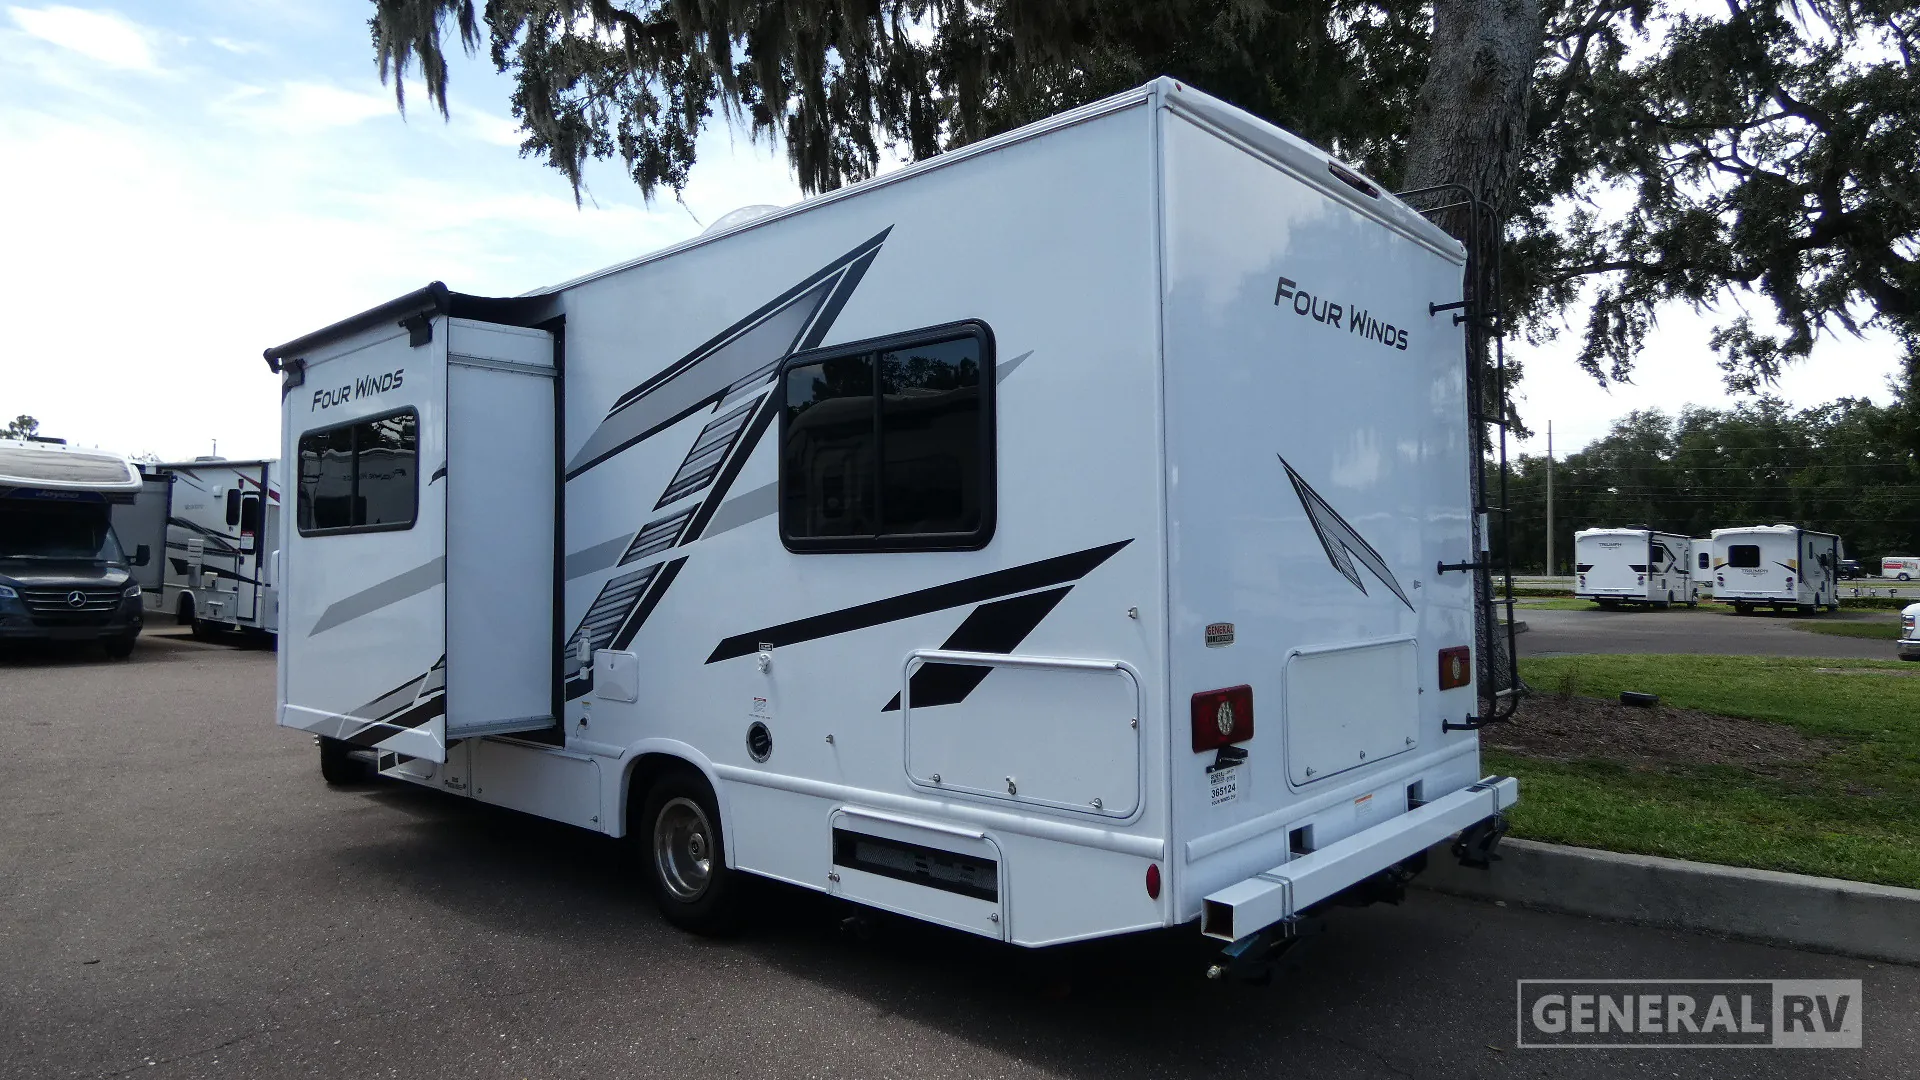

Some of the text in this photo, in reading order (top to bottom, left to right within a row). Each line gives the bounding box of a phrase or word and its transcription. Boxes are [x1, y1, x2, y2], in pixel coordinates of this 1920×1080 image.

[1274, 276, 1409, 351] FOUR WINDS
[311, 368, 405, 412] FOUR WINDS
[1207, 625, 1234, 636] GENERAL
[1211, 783, 1236, 799] 365124
